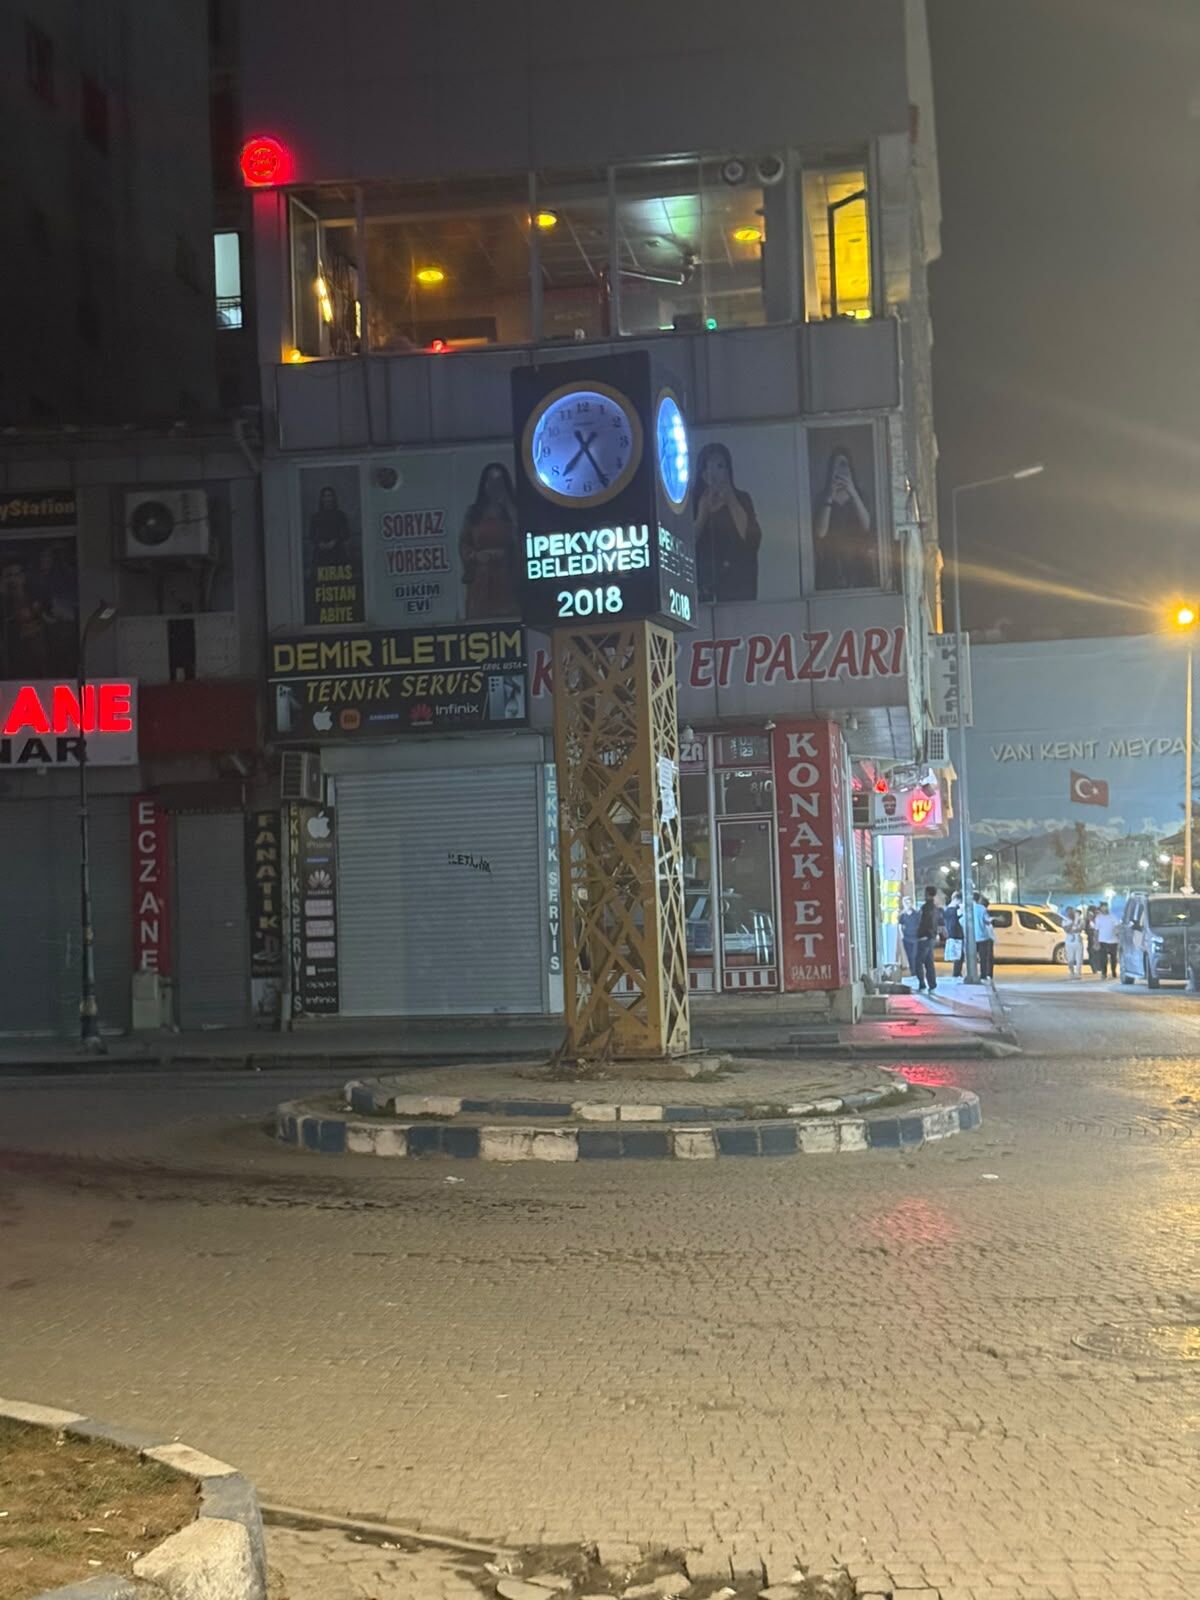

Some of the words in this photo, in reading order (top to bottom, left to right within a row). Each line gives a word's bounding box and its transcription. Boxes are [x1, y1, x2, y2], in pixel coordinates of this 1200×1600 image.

[383, 511, 444, 538] SORYAZ
[526, 524, 649, 559] İPEKYOLU
[386, 546, 449, 573] YÖRESEL
[527, 545, 650, 580] BELEDİYESİ
[556, 585, 624, 618] 2018
[669, 588, 691, 621] 2018
[273, 638, 373, 673] DEMİR
[382, 630, 522, 665] İLETİŞİM
[690, 638, 741, 688] ET
[744, 627, 905, 685] PAZARI
[306, 678, 391, 704] TEKNİK
[400, 672, 485, 698] SERVİS
[3, 683, 133, 735] ANE
[991, 743, 1033, 762] VAN
[1041, 740, 1099, 760] KENT
[786, 732, 824, 879] KONAK
[138, 802, 160, 972] ECZANE
[794, 899, 825, 958] ET
